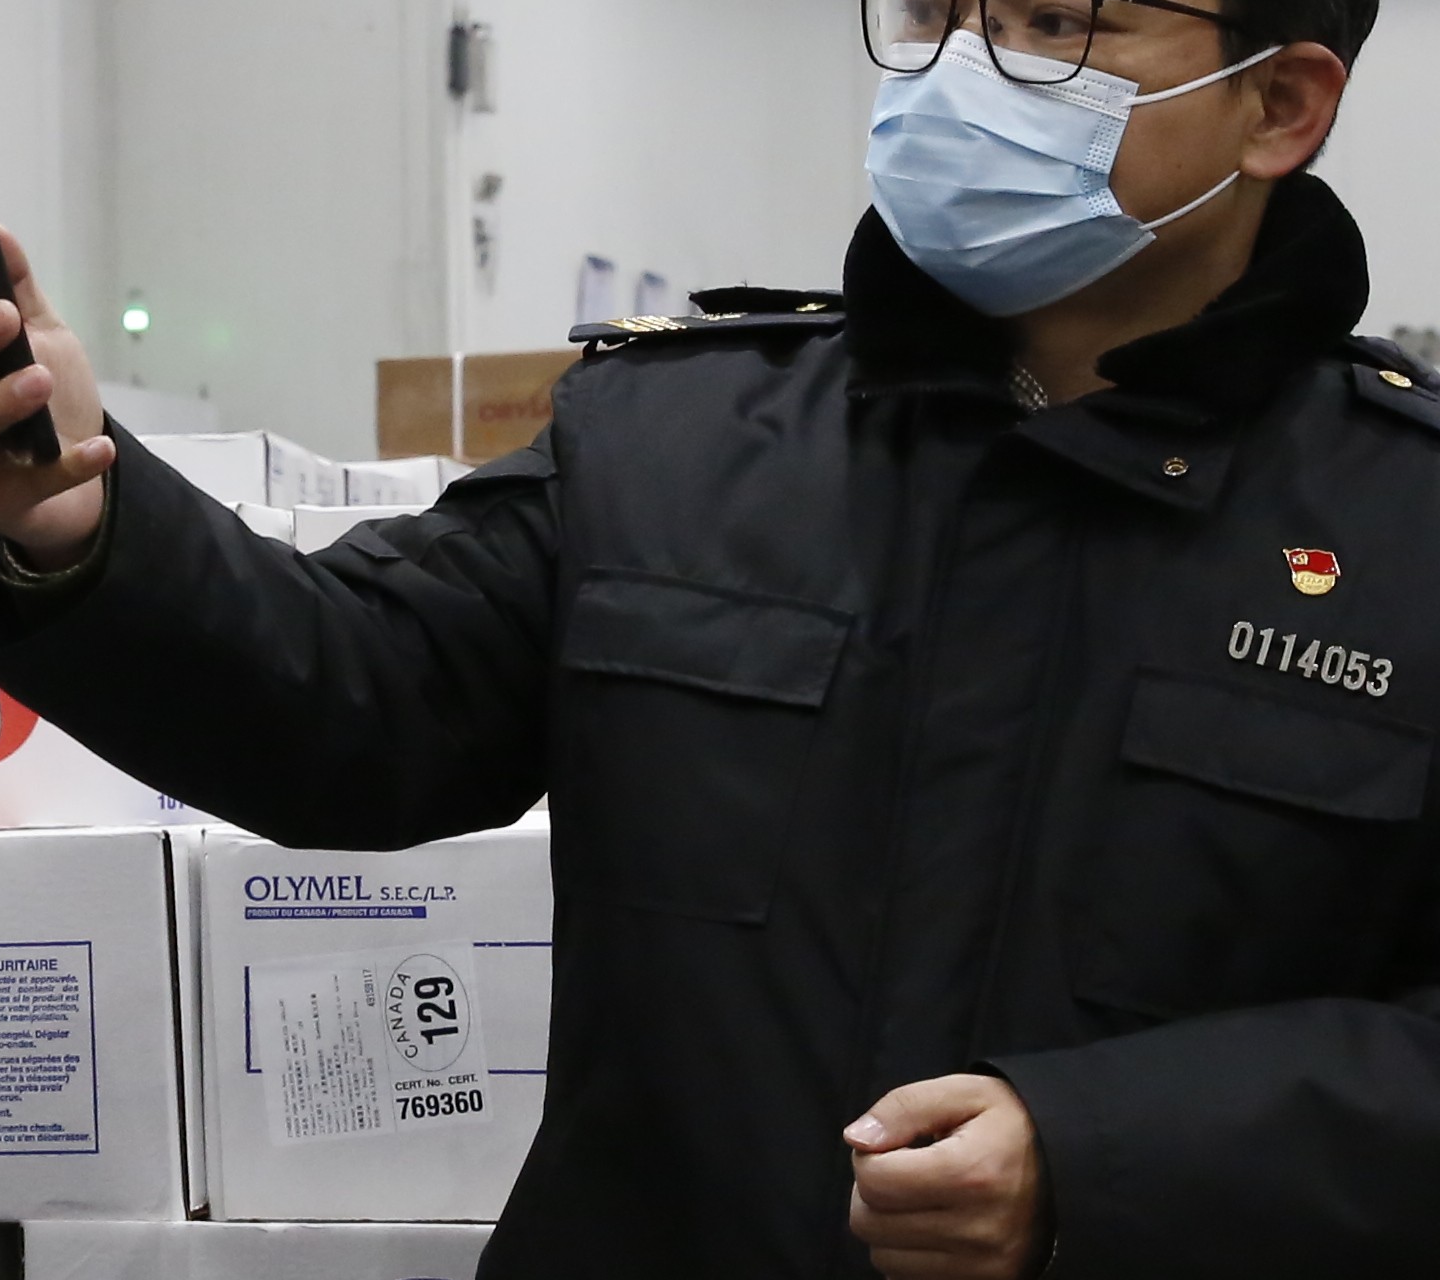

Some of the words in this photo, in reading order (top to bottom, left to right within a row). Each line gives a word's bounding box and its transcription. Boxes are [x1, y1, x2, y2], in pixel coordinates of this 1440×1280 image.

[1226, 620, 1394, 698] 0114053
[244, 875, 372, 902] OLYMEL
[294, 907, 326, 918] CANADA
[380, 907, 413, 917] CANADA
[389, 972, 418, 1059] CANADA
[413, 976, 459, 1045] 129
[394, 1079, 425, 1092] CERT.
[426, 1078, 443, 1088] No.
[448, 1073, 479, 1086] CERT.
[396, 1088, 484, 1121] 769360
